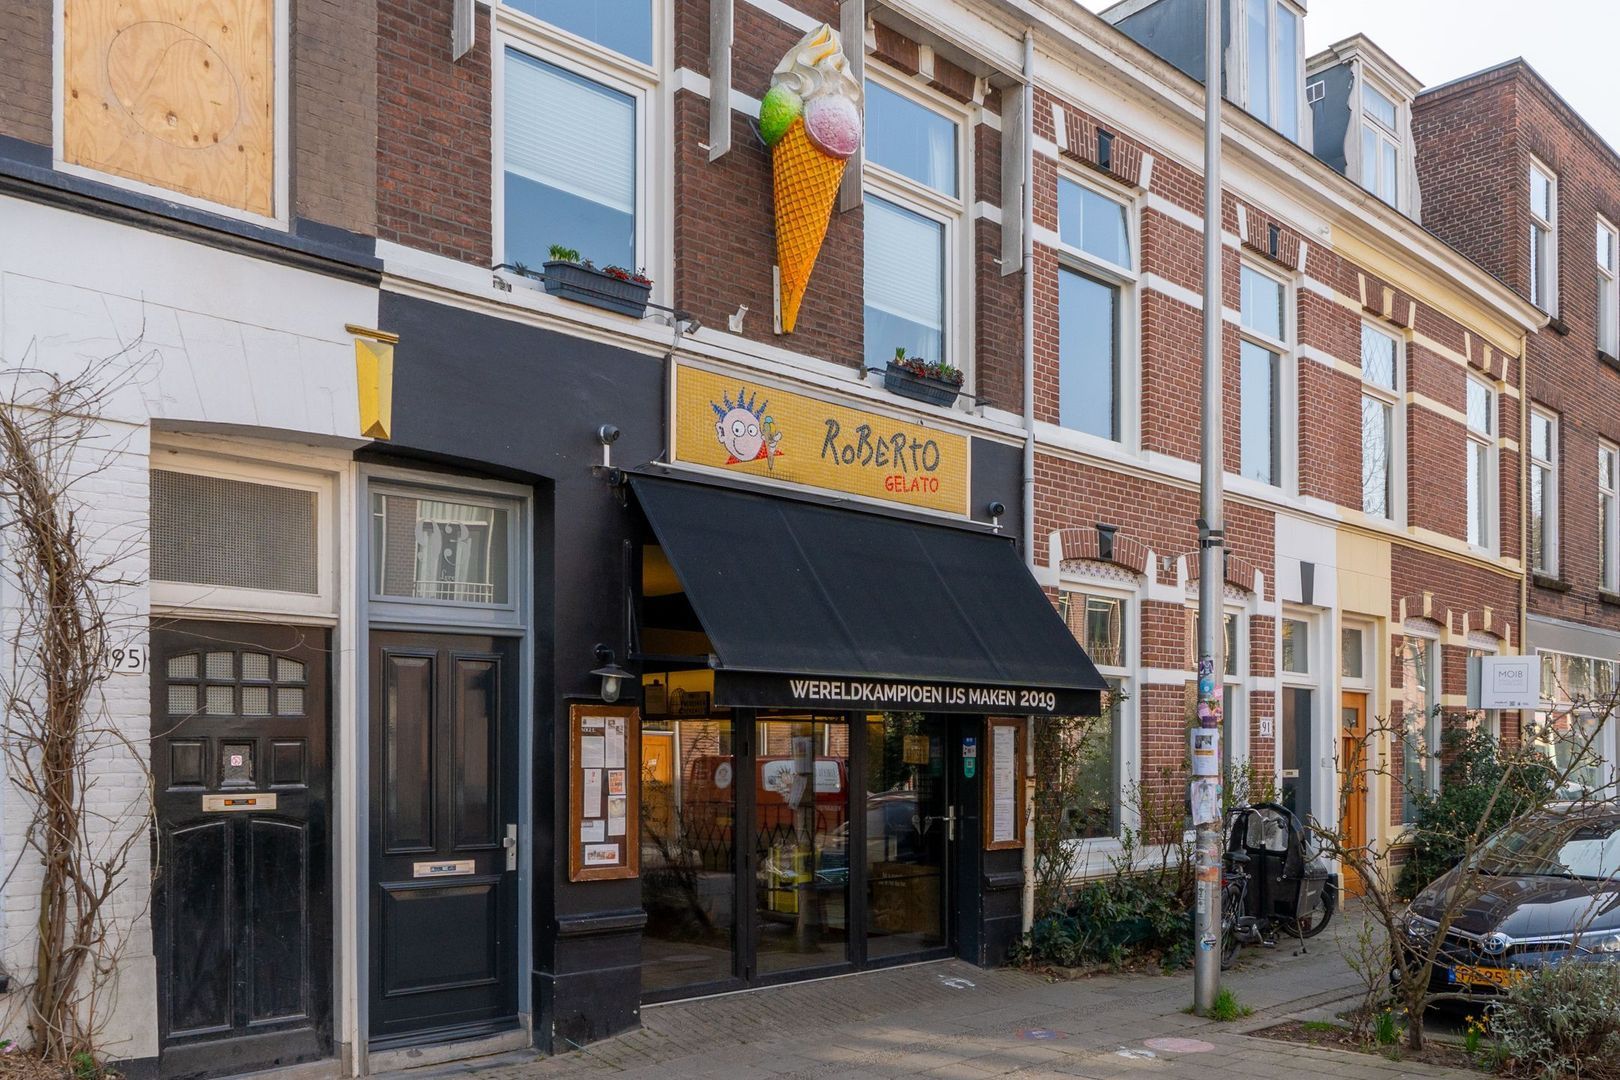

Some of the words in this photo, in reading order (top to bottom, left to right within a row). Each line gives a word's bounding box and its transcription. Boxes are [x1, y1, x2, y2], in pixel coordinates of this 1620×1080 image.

[884, 475, 939, 493] GELATO
[112, 648, 140, 668] 95
[789, 680, 942, 704] WERELDKAMPIOEN
[946, 687, 966, 704] IJS
[968, 688, 1016, 706] MAKEN
[1020, 690, 1056, 711] 2019
[1262, 721, 1270, 733] 91
